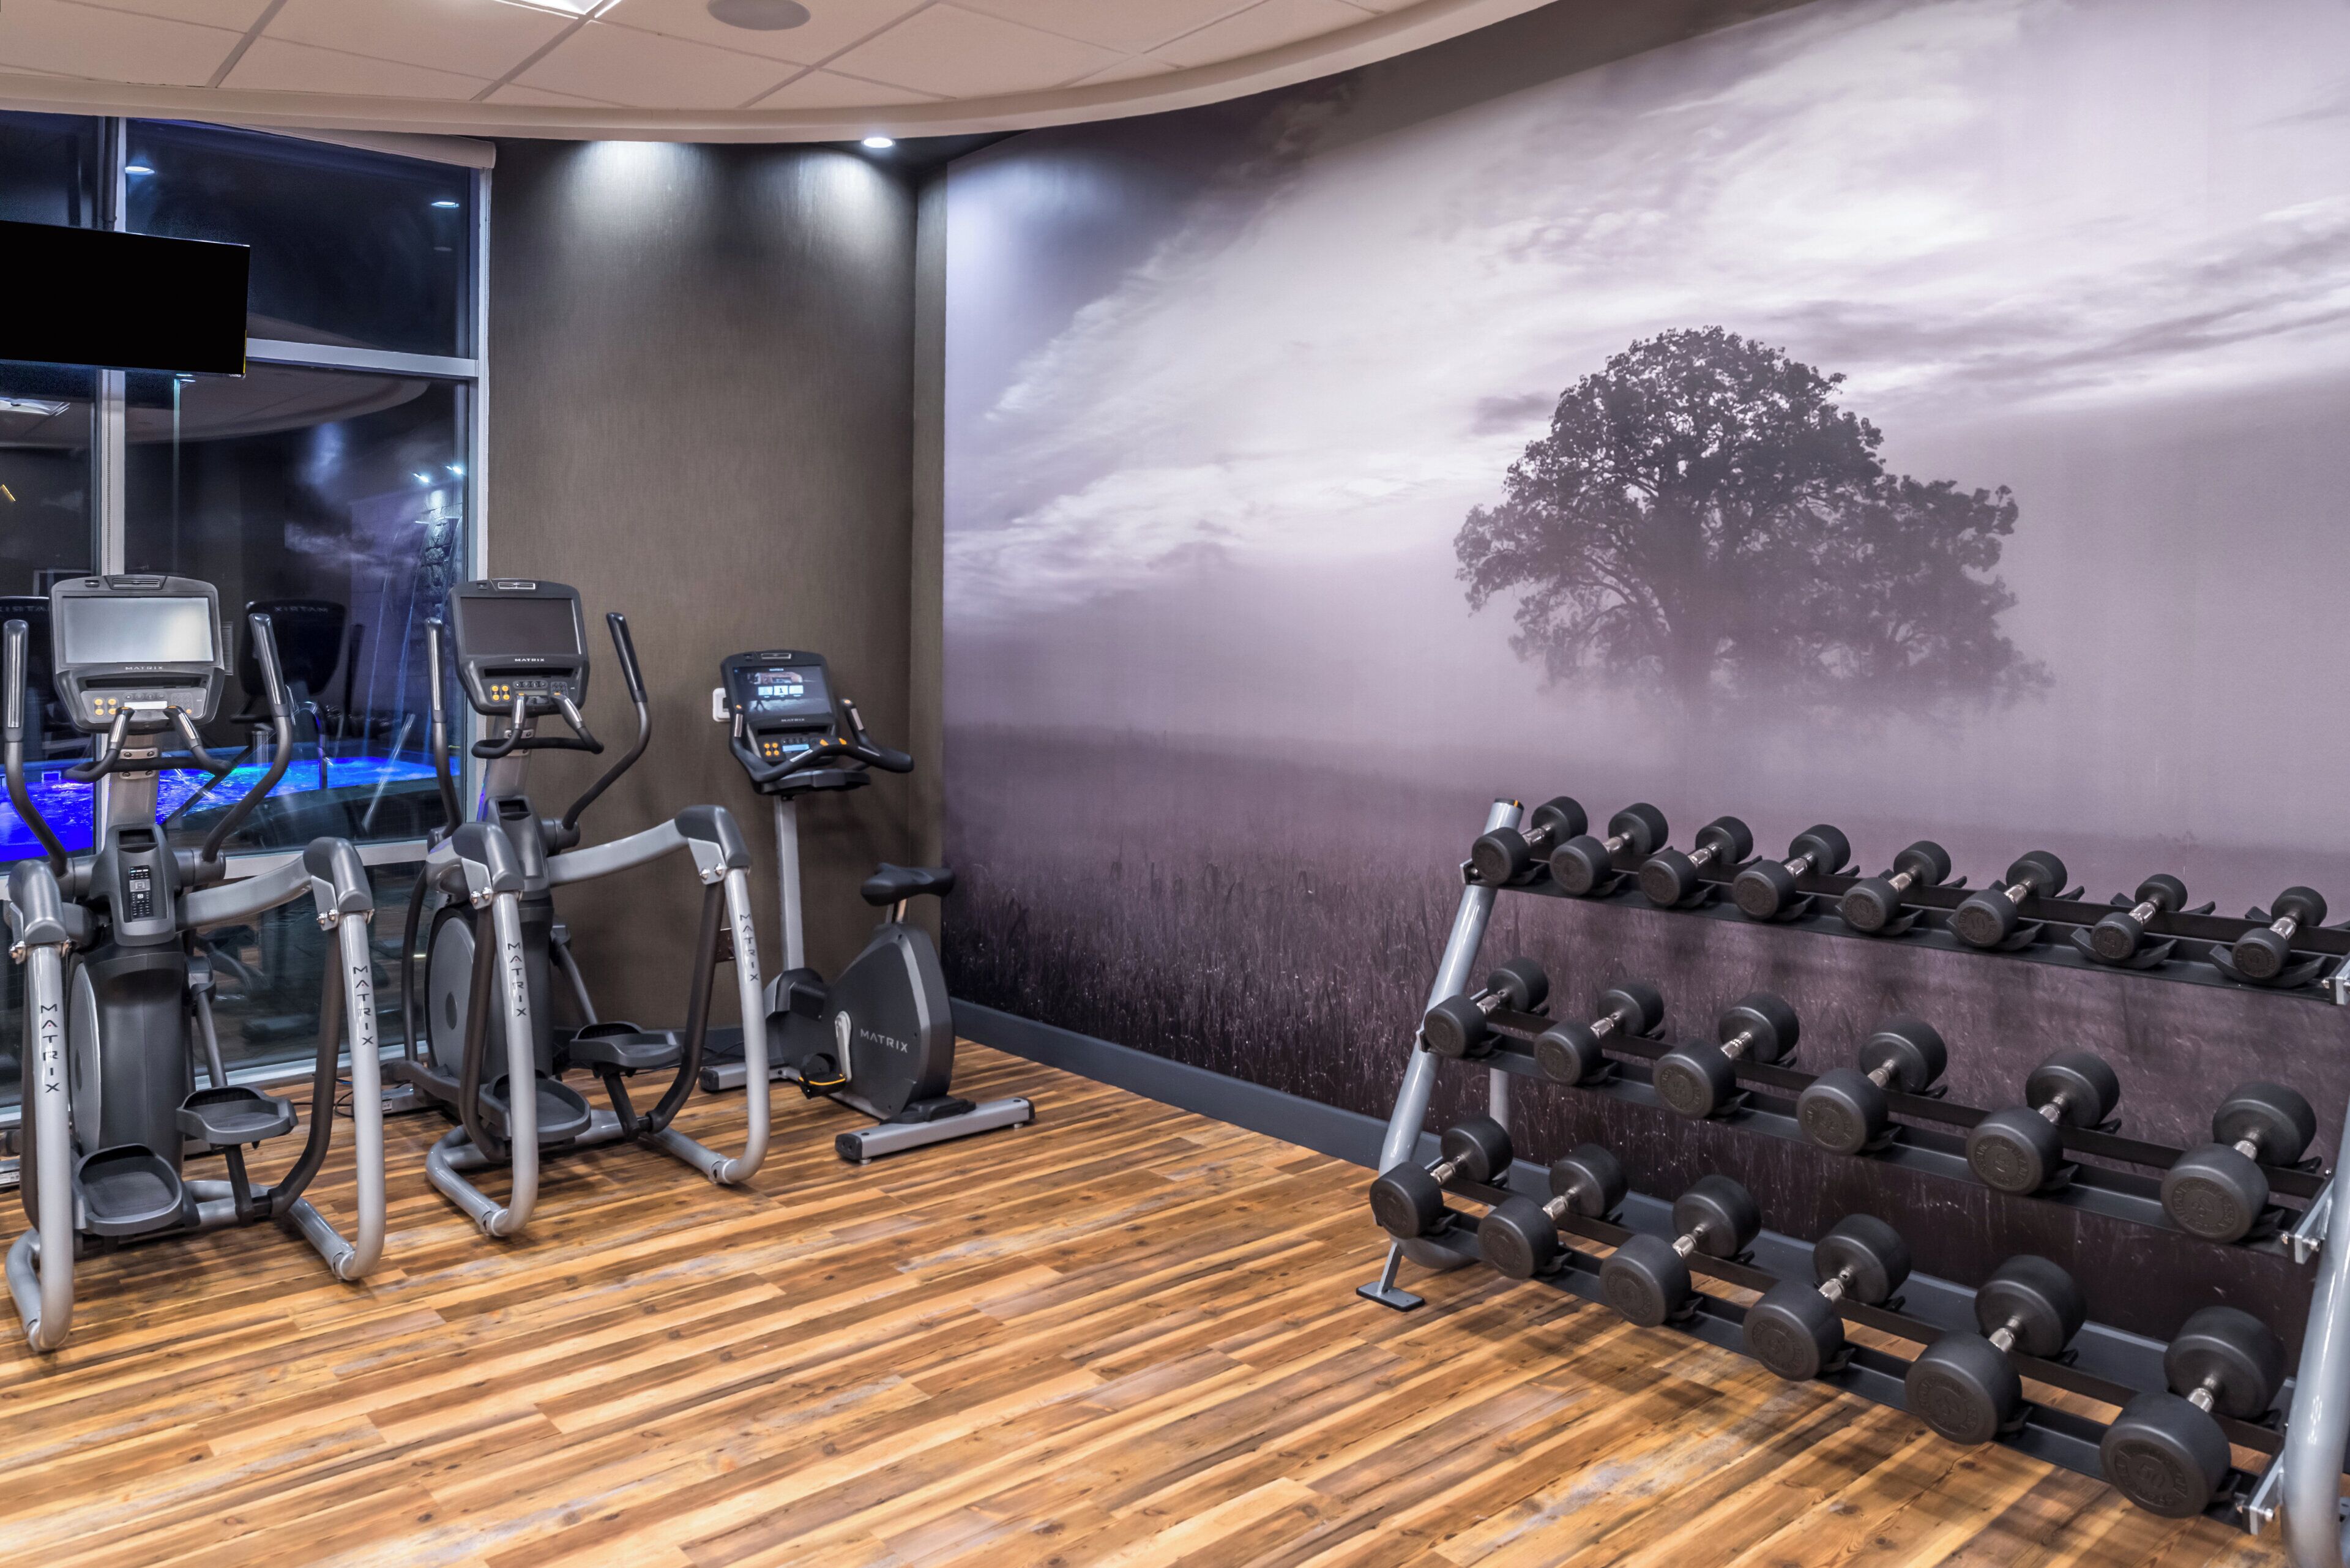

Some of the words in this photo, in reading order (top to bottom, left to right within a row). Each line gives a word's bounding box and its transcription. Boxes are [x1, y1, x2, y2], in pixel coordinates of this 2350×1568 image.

[507, 942, 527, 1017] MATRIX
[740, 914, 759, 981] MATRIX
[353, 965, 373, 1045] MATRIX
[860, 1028, 908, 1053] MATRIX
[41, 1004, 60, 1093] MATRIX
